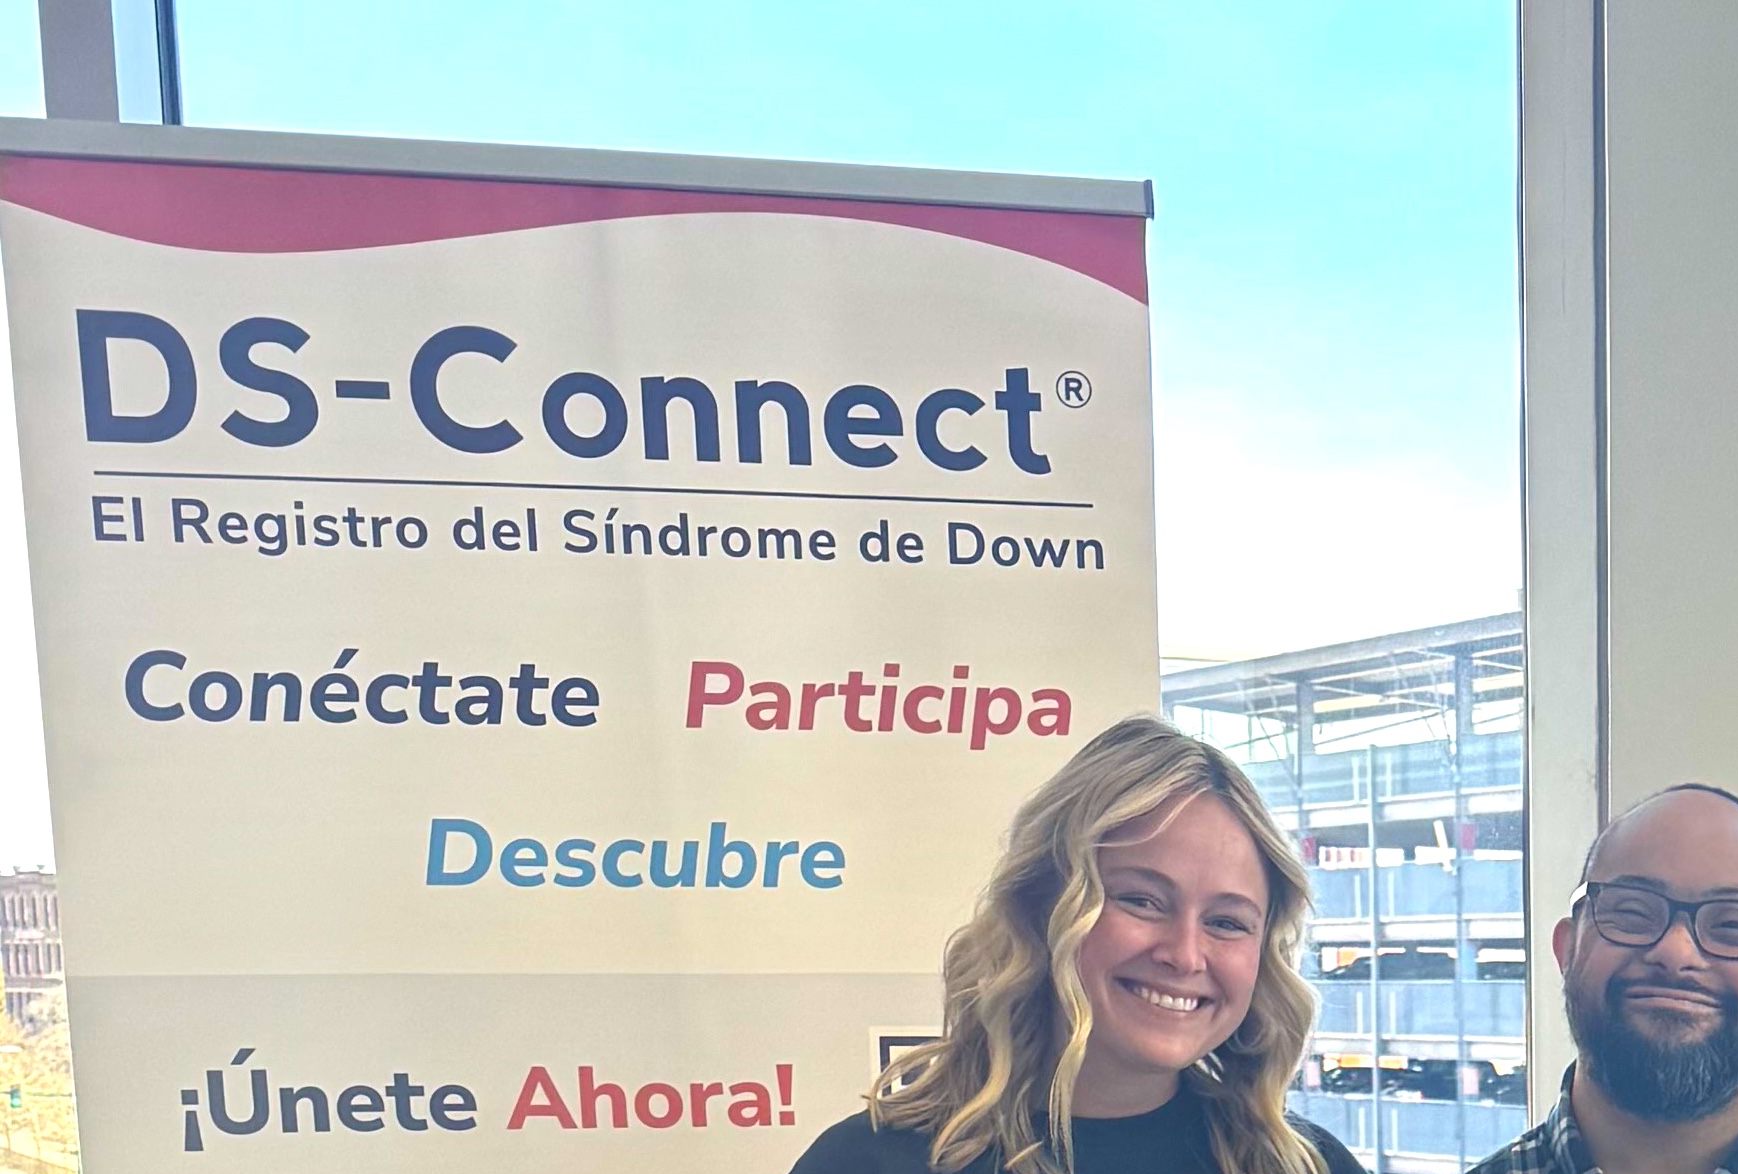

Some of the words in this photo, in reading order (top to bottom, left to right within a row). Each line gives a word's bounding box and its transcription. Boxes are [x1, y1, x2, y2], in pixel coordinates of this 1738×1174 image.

[90, 494, 146, 545] El
[173, 497, 430, 557] Registro
[451, 505, 538, 554] del
[562, 508, 838, 563] Síndrome
[859, 519, 925, 565] de
[947, 522, 1105, 571] Down
[124, 647, 601, 728] Conéctate
[685, 660, 1073, 751] Participa
[425, 817, 846, 889] Descubre
[180, 1048, 478, 1152] ¡Únete
[506, 1064, 797, 1131] Ahora!
